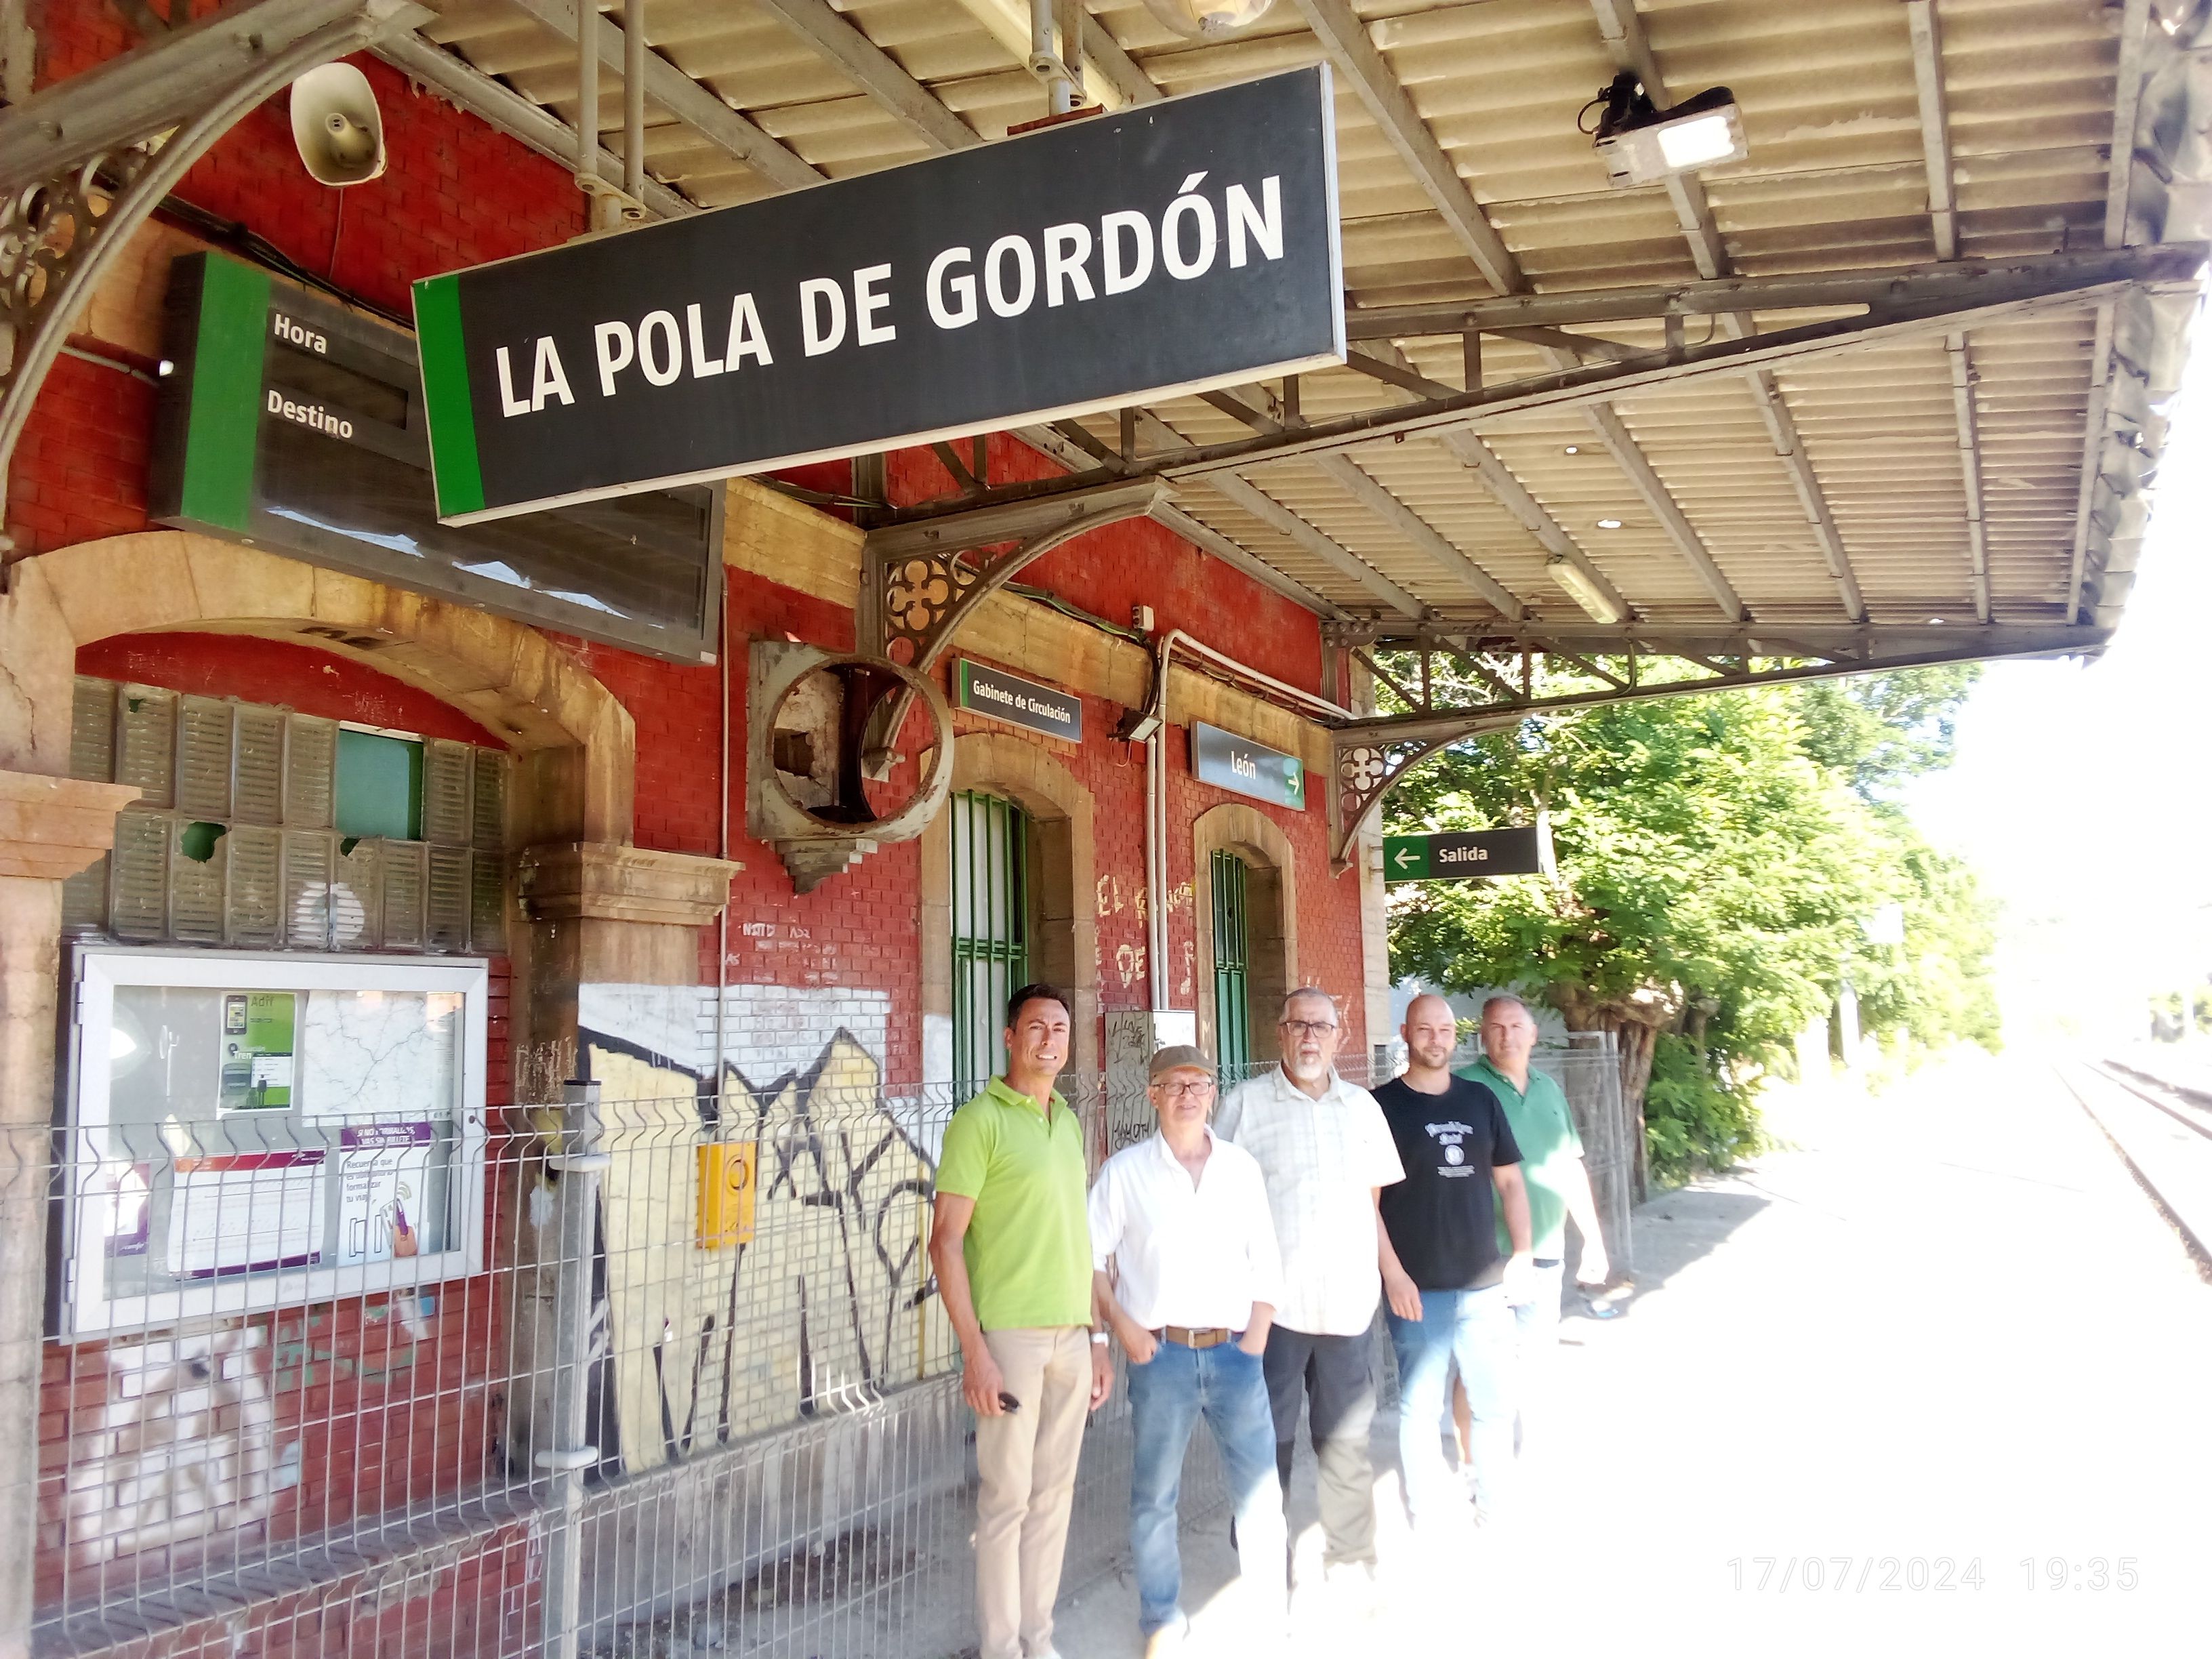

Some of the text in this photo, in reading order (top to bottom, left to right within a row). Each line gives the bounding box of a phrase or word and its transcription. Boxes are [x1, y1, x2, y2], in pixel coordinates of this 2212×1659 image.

[496, 170, 1284, 417] LA POLA DE GORDÓN
[274, 313, 327, 354] Hora
[268, 390, 353, 438] Destino
[973, 680, 1071, 724] Gabinete de Circulación
[1231, 750, 1256, 780] León
[1439, 846, 1488, 863] Salida
[251, 995, 274, 1007] Adif
[233, 1050, 251, 1060] Tren
[346, 1160, 378, 1168] Recuera
